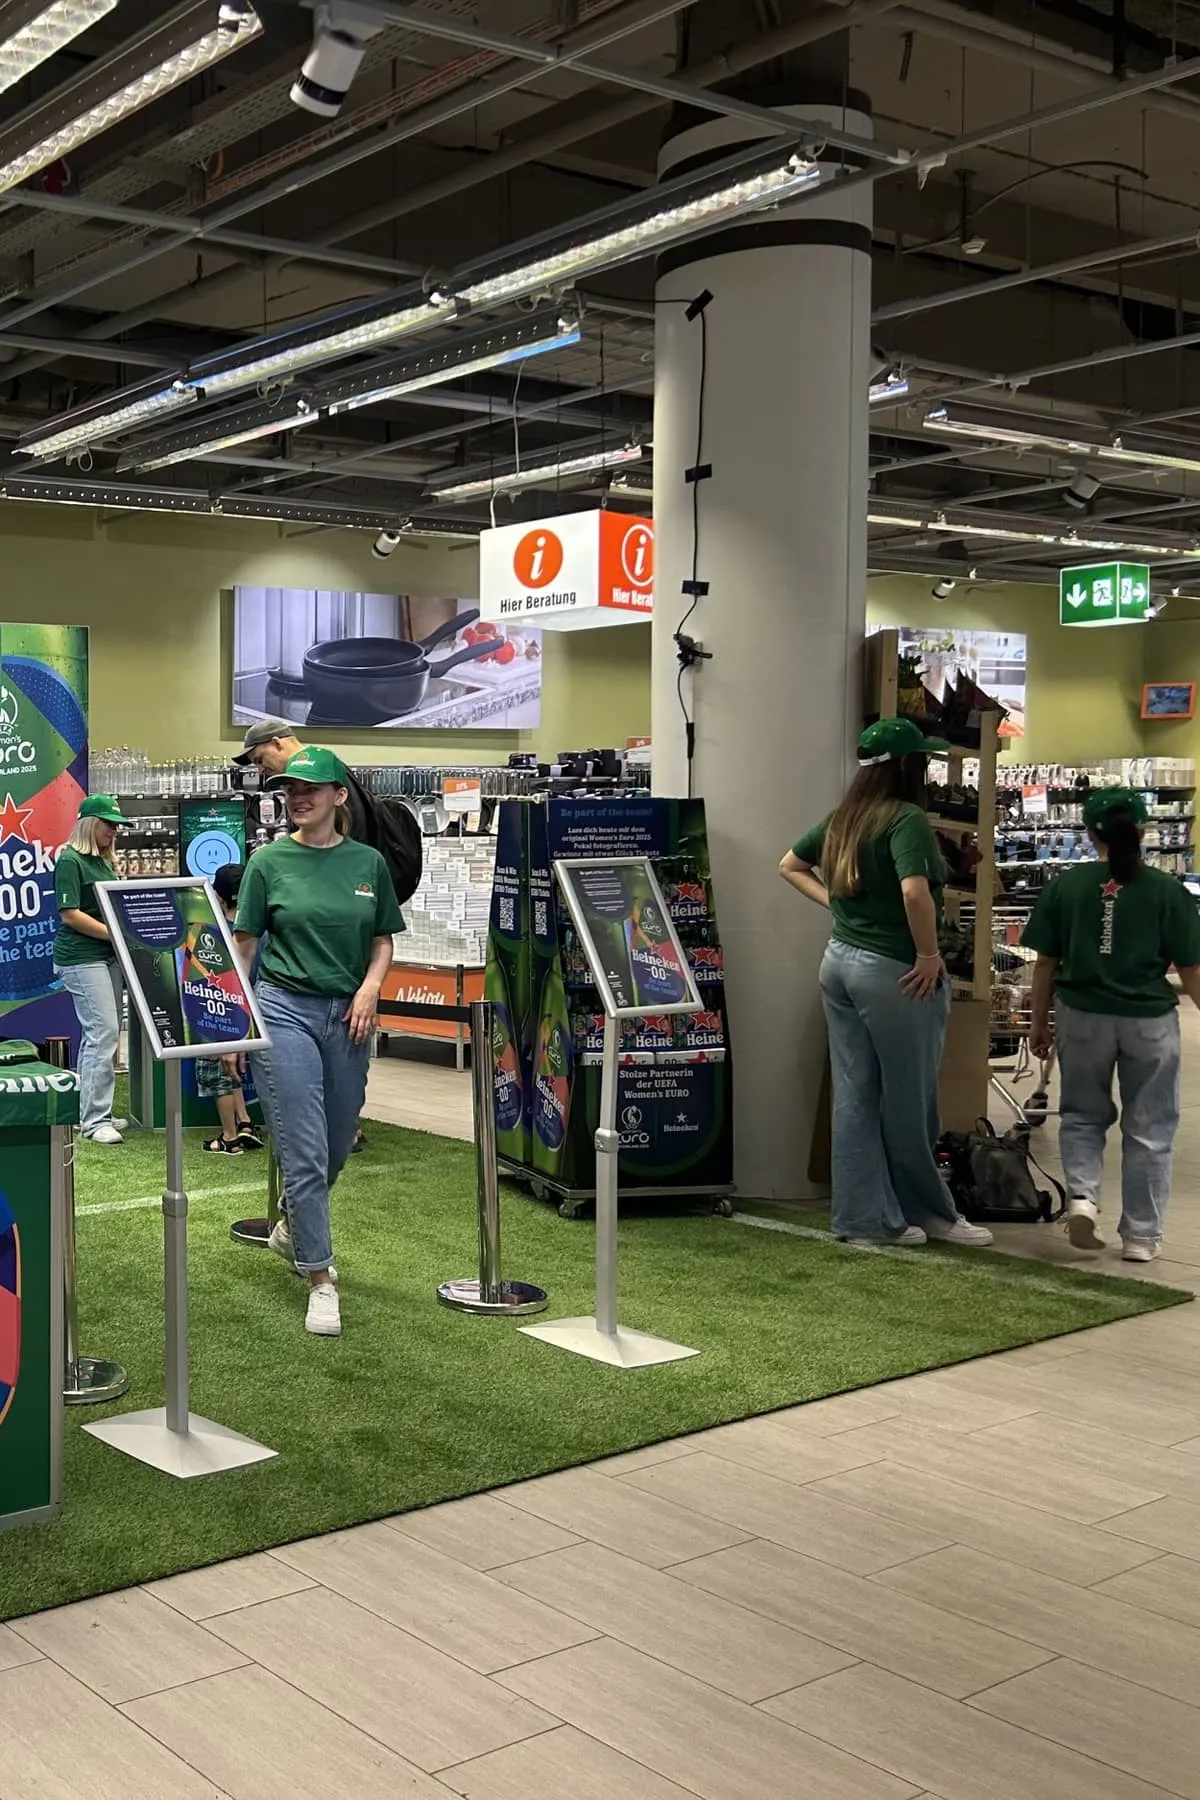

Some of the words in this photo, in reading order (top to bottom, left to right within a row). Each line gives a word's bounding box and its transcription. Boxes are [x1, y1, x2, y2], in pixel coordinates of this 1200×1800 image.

[500, 598, 522, 613] Hier
[526, 591, 577, 610] Beratung
[612, 588, 630, 603] Hier
[21, 765, 37, 773] 2025
[561, 808, 572, 817] Be
[574, 809, 594, 819] part
[596, 808, 606, 816] of
[608, 808, 623, 816] the
[562, 835, 588, 843] original
[589, 834, 618, 842] Women's
[573, 842, 591, 850] Pokal
[670, 904, 708, 918] Heine
[14, 916, 56, 944] part
[1100, 899, 1115, 954] Heineken
[23, 941, 54, 960] tea
[632, 948, 681, 972] Heineken
[184, 981, 245, 1006] Heineken
[205, 1021, 219, 1030] the
[219, 1024, 241, 1034] team
[214, 1016, 232, 1026] part
[635, 1034, 673, 1048] Heine
[686, 1032, 725, 1046] Heine
[619, 1069, 648, 1078] Stolze
[649, 1067, 694, 1078] Partnerin
[636, 1079, 652, 1088] der
[654, 1079, 678, 1088] UEFA
[624, 1089, 663, 1099] Women's
[664, 1089, 690, 1098] EURO
[663, 1124, 699, 1132] Heineken
